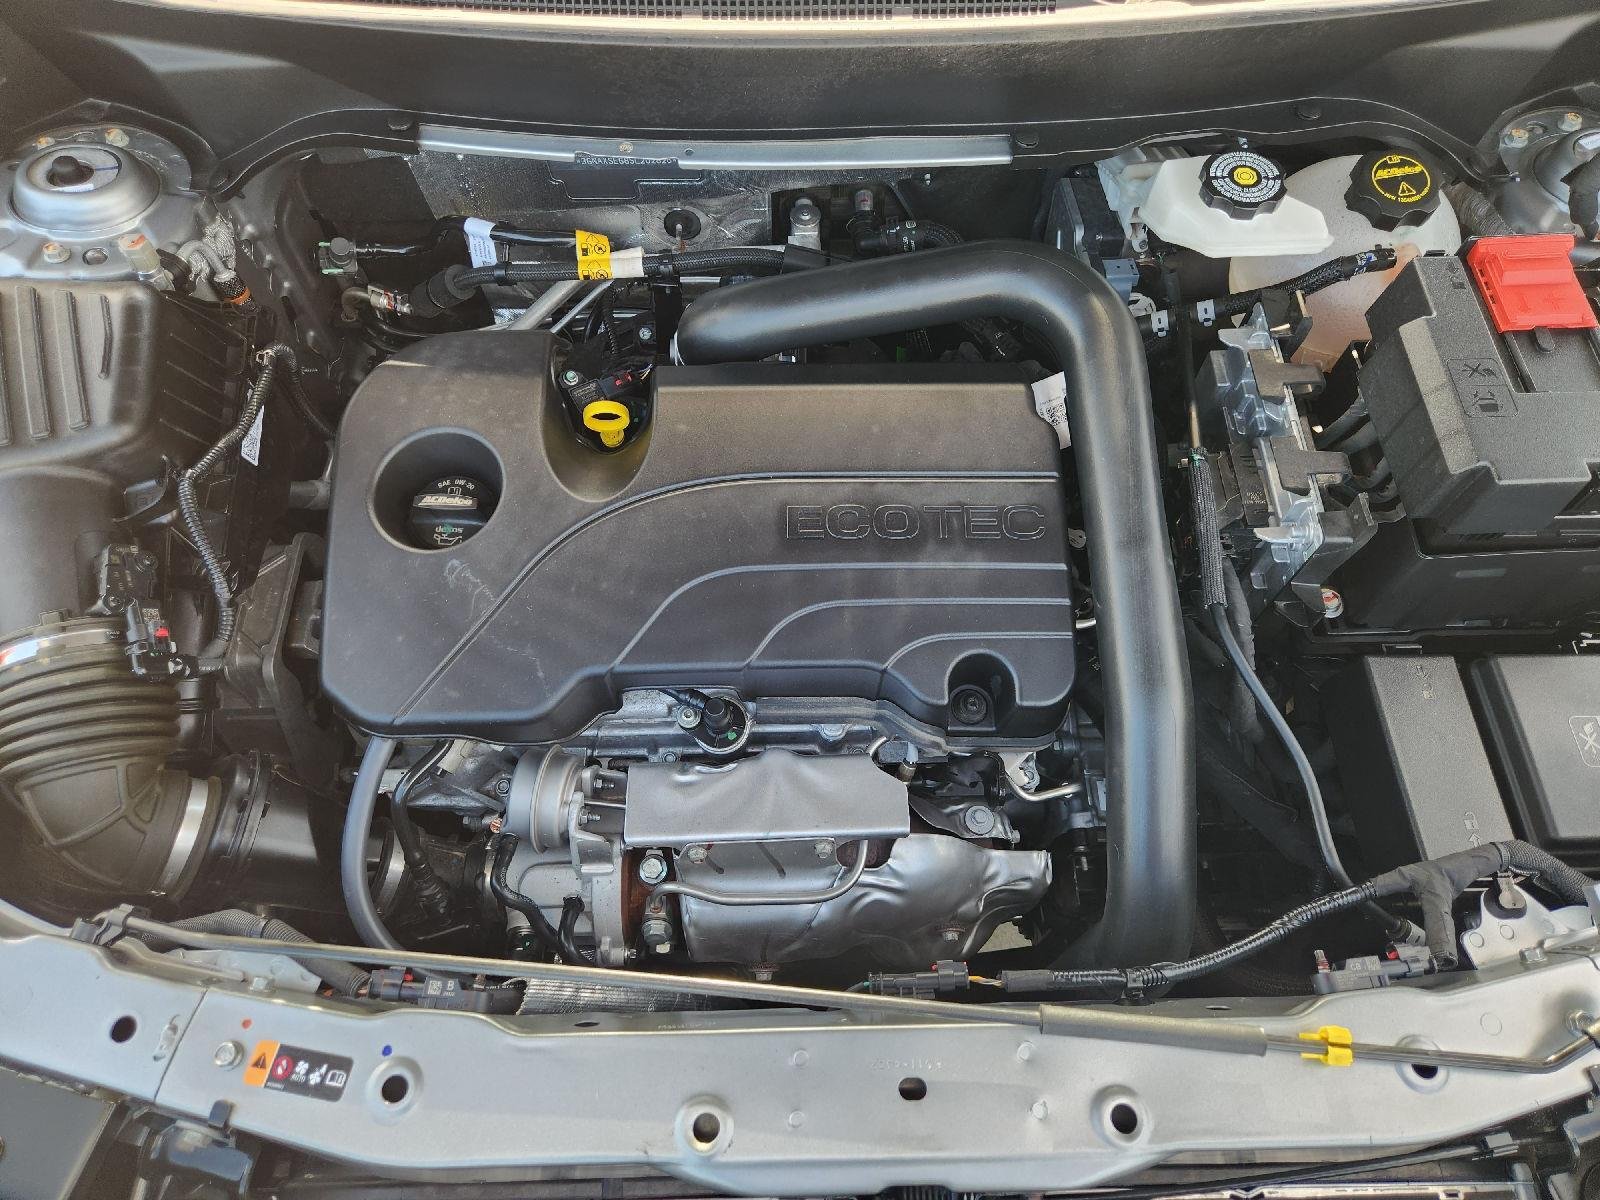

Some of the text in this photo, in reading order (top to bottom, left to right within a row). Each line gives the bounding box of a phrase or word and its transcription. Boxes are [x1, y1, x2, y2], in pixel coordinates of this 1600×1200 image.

[437, 479, 475, 490] SAE 0W-20
[418, 495, 473, 506] ACDelco
[786, 504, 1046, 540] ECOTEC
[447, 980, 455, 990] B
